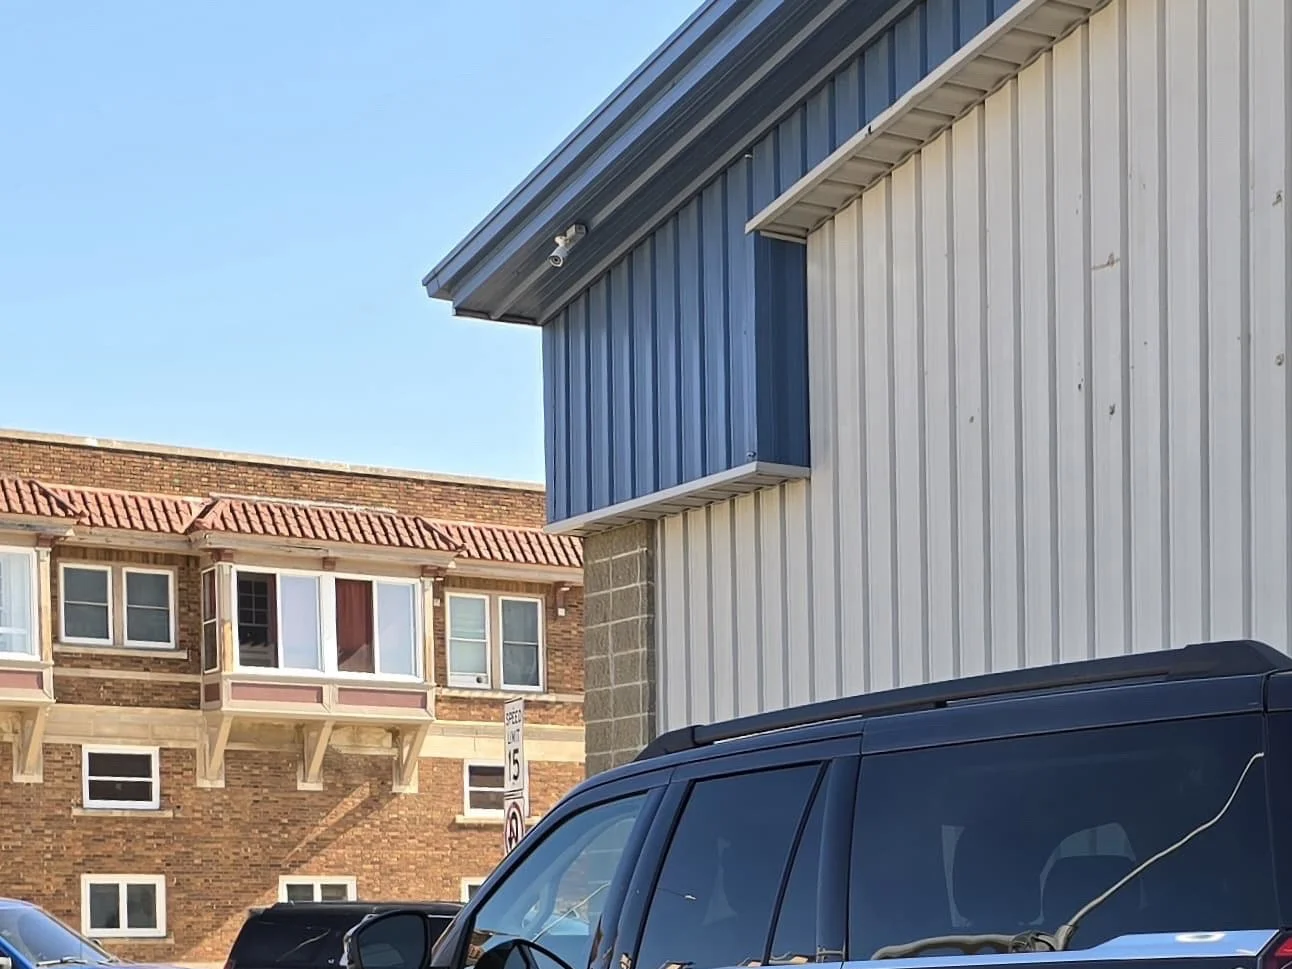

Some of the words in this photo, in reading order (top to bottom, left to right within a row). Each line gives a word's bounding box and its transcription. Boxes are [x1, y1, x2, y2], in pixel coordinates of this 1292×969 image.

[505, 708, 522, 725] SPEED
[507, 728, 520, 744] LIMIT
[508, 748, 520, 781] 15
